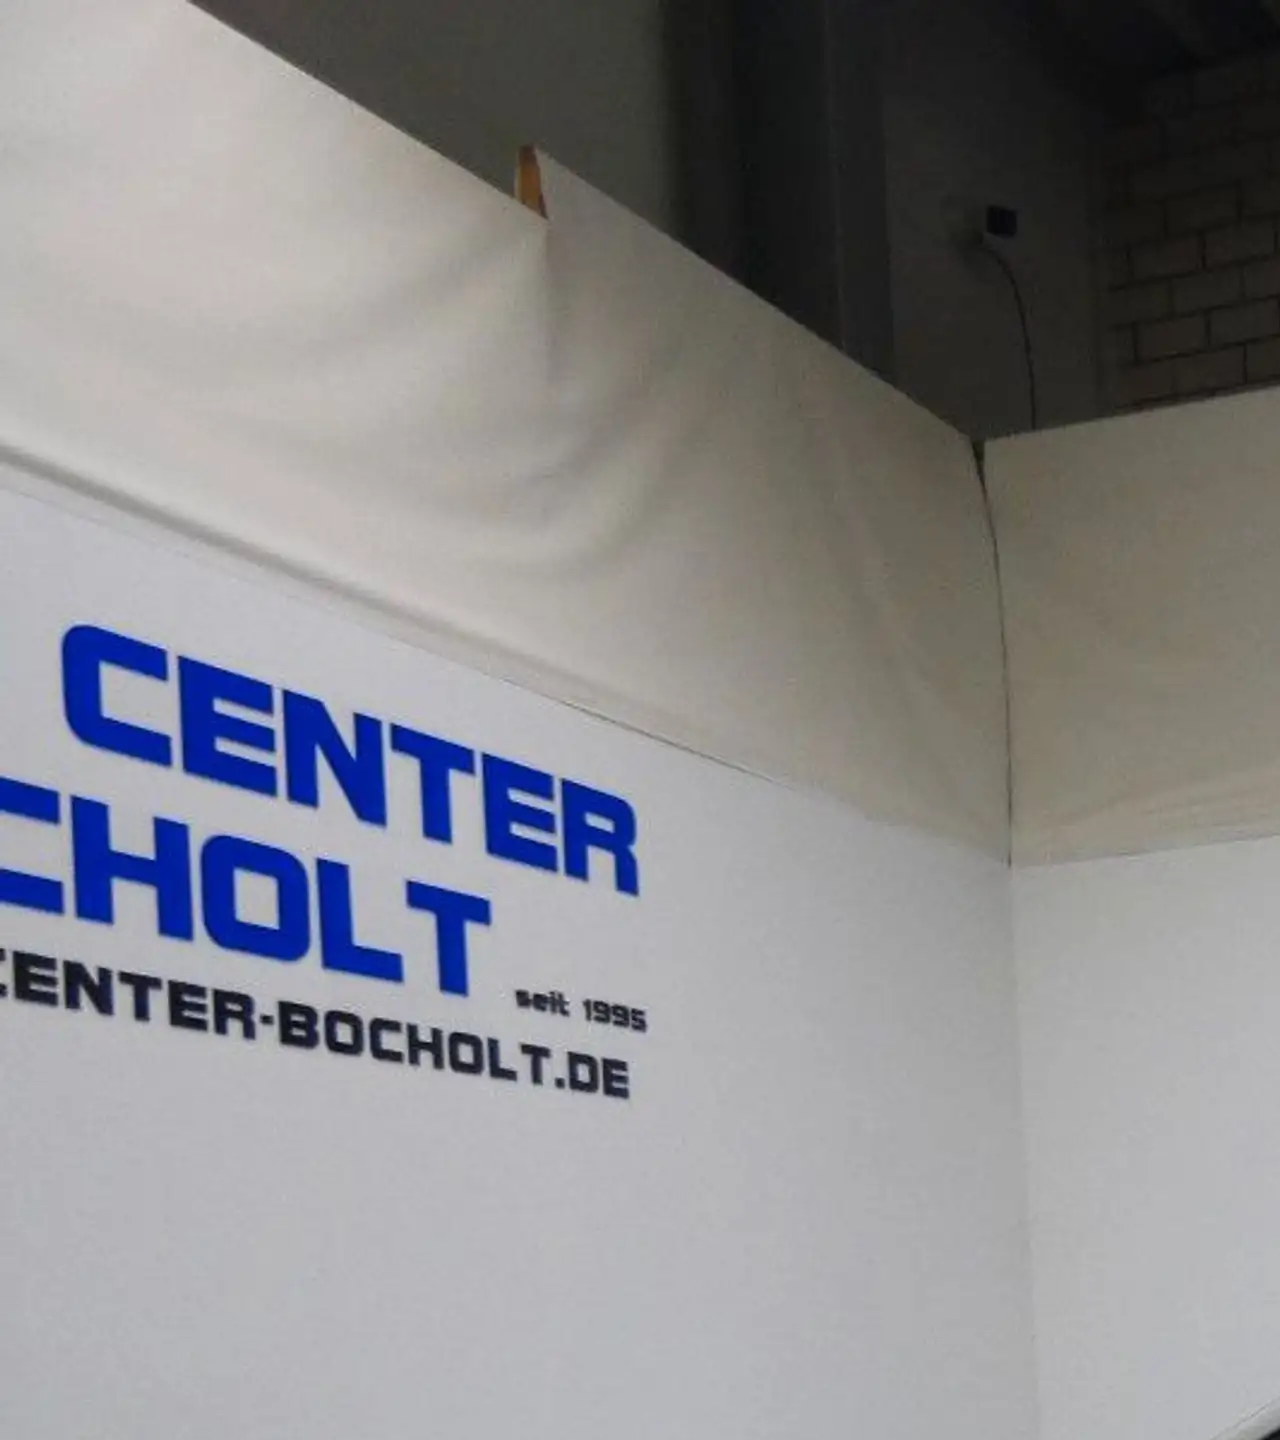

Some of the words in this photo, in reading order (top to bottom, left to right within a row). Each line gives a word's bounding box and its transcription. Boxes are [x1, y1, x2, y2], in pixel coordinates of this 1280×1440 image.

[61, 624, 639, 896] CENTER
[0, 947, 630, 1101] ENTER-BOCHOLT.DE
[514, 988, 570, 1018] seit
[582, 998, 648, 1033] 1995
